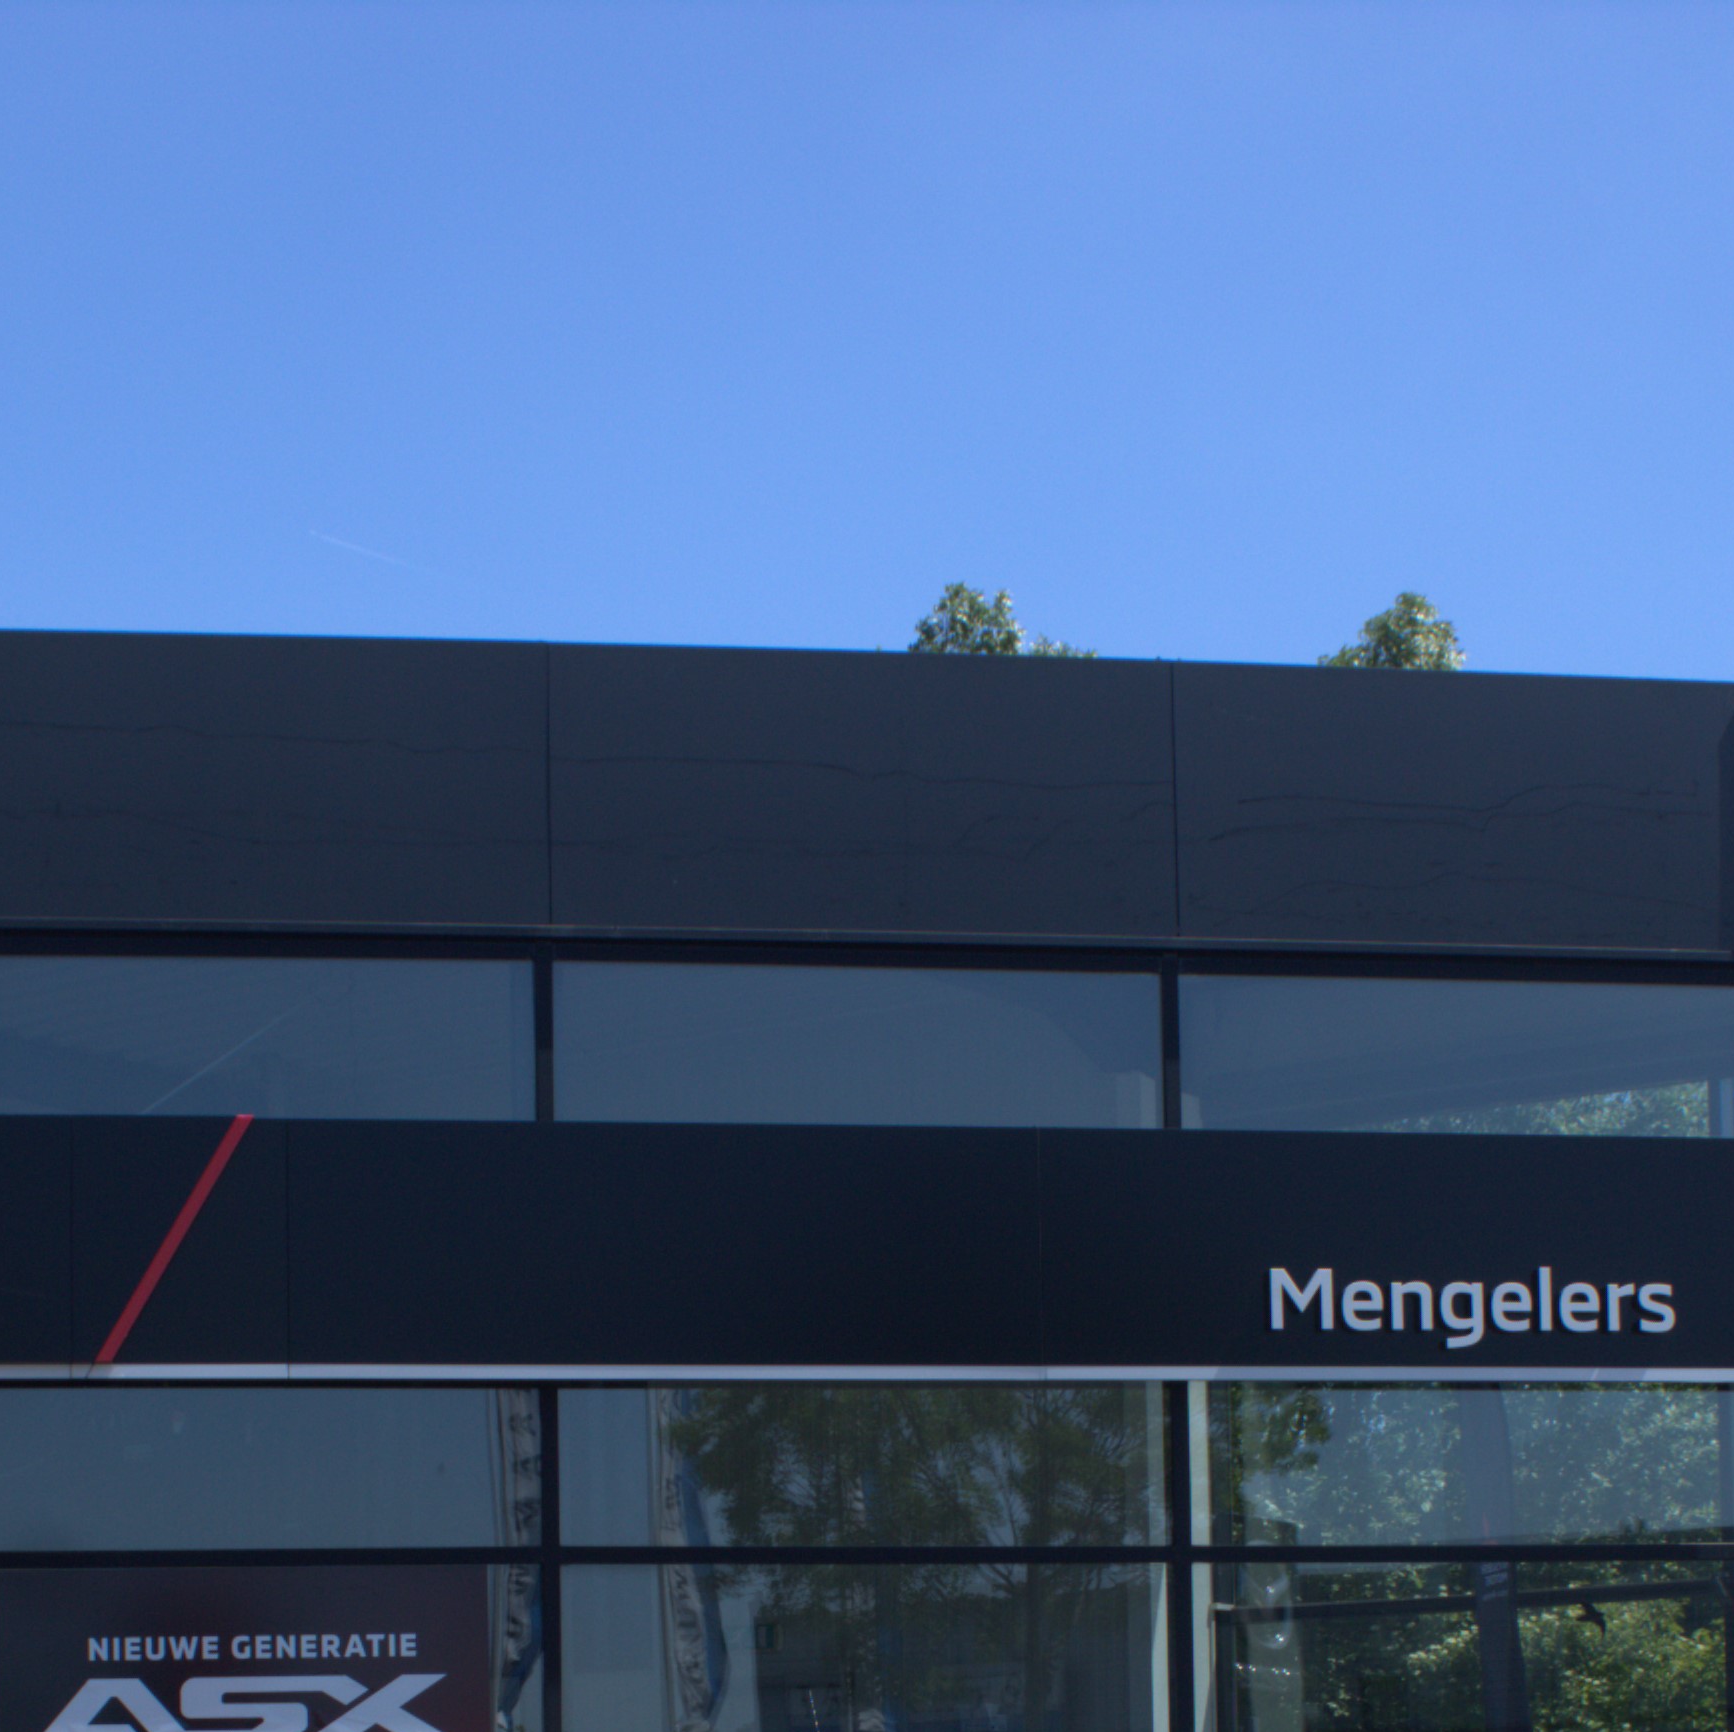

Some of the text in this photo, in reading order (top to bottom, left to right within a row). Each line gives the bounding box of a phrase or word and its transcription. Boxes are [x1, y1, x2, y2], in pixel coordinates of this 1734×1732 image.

[1269, 1266, 1676, 1350] Mengelers
[88, 1633, 418, 1662] NIEUWE GENERATIE
